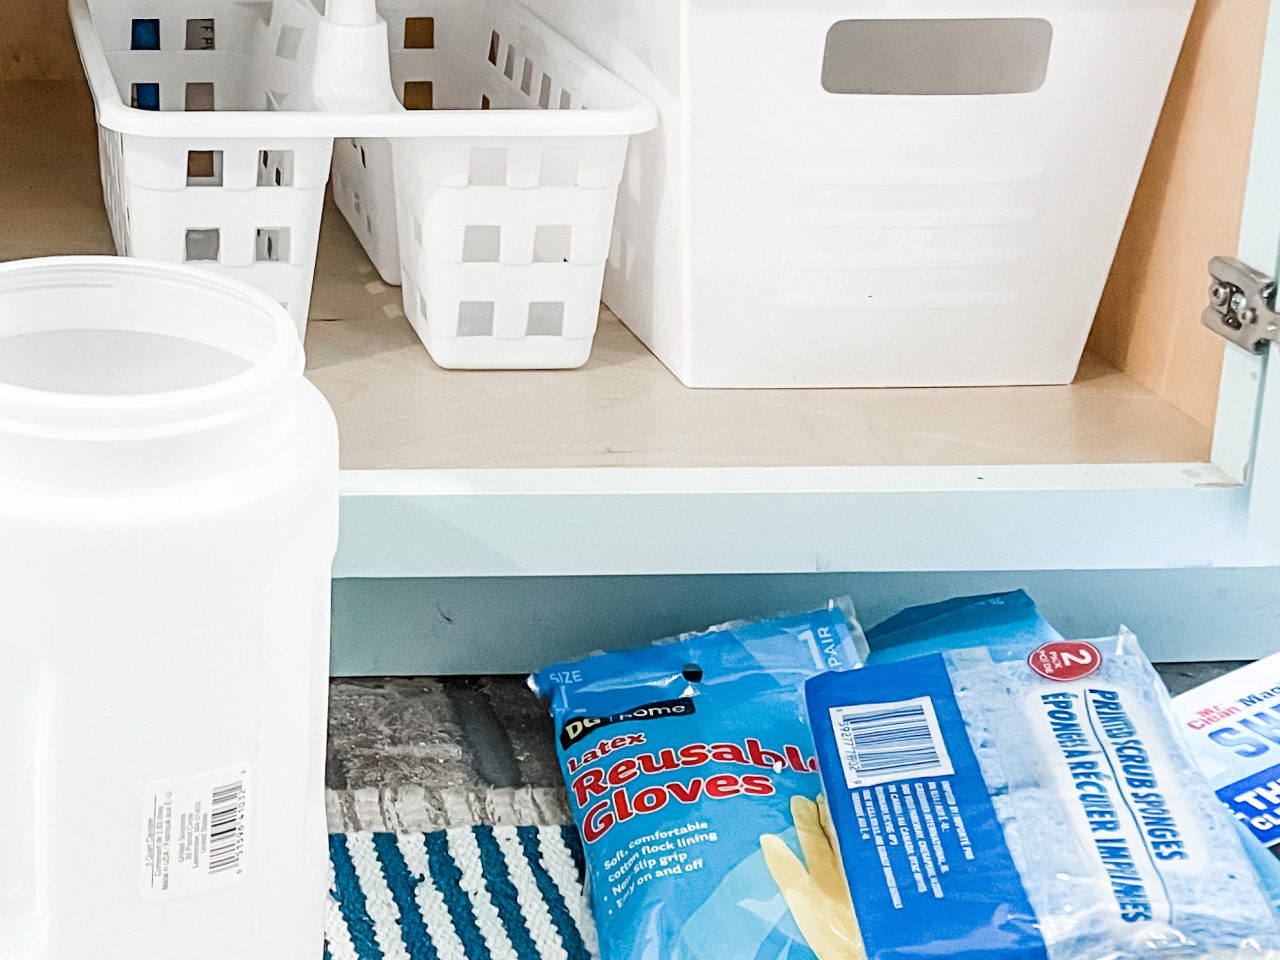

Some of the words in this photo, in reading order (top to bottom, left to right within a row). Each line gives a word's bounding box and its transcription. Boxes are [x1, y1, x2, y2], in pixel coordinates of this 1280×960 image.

[797, 629, 825, 670] 1
[817, 626, 842, 667] PAIR
[1060, 649, 1092, 666] 2
[549, 670, 583, 684] SIZE
[565, 718, 601, 740] DG
[1088, 689, 1138, 739] PRINTED
[1187, 706, 1241, 730] Clean
[567, 733, 647, 773] Latex
[1111, 739, 1158, 789] SCRUB
[582, 773, 775, 844] Gloves
[1067, 760, 1120, 833] RÉCURER
[604, 849, 628, 870] Soft,
[628, 821, 708, 849] comfortable
[1130, 792, 1189, 861] SPONGES
[608, 852, 640, 882] cotton
[641, 841, 675, 856] flock
[677, 832, 718, 848] lining
[636, 873, 653, 886] on
[655, 864, 683, 878] and
[684, 858, 704, 872] off
[659, 852, 688, 866] grip
